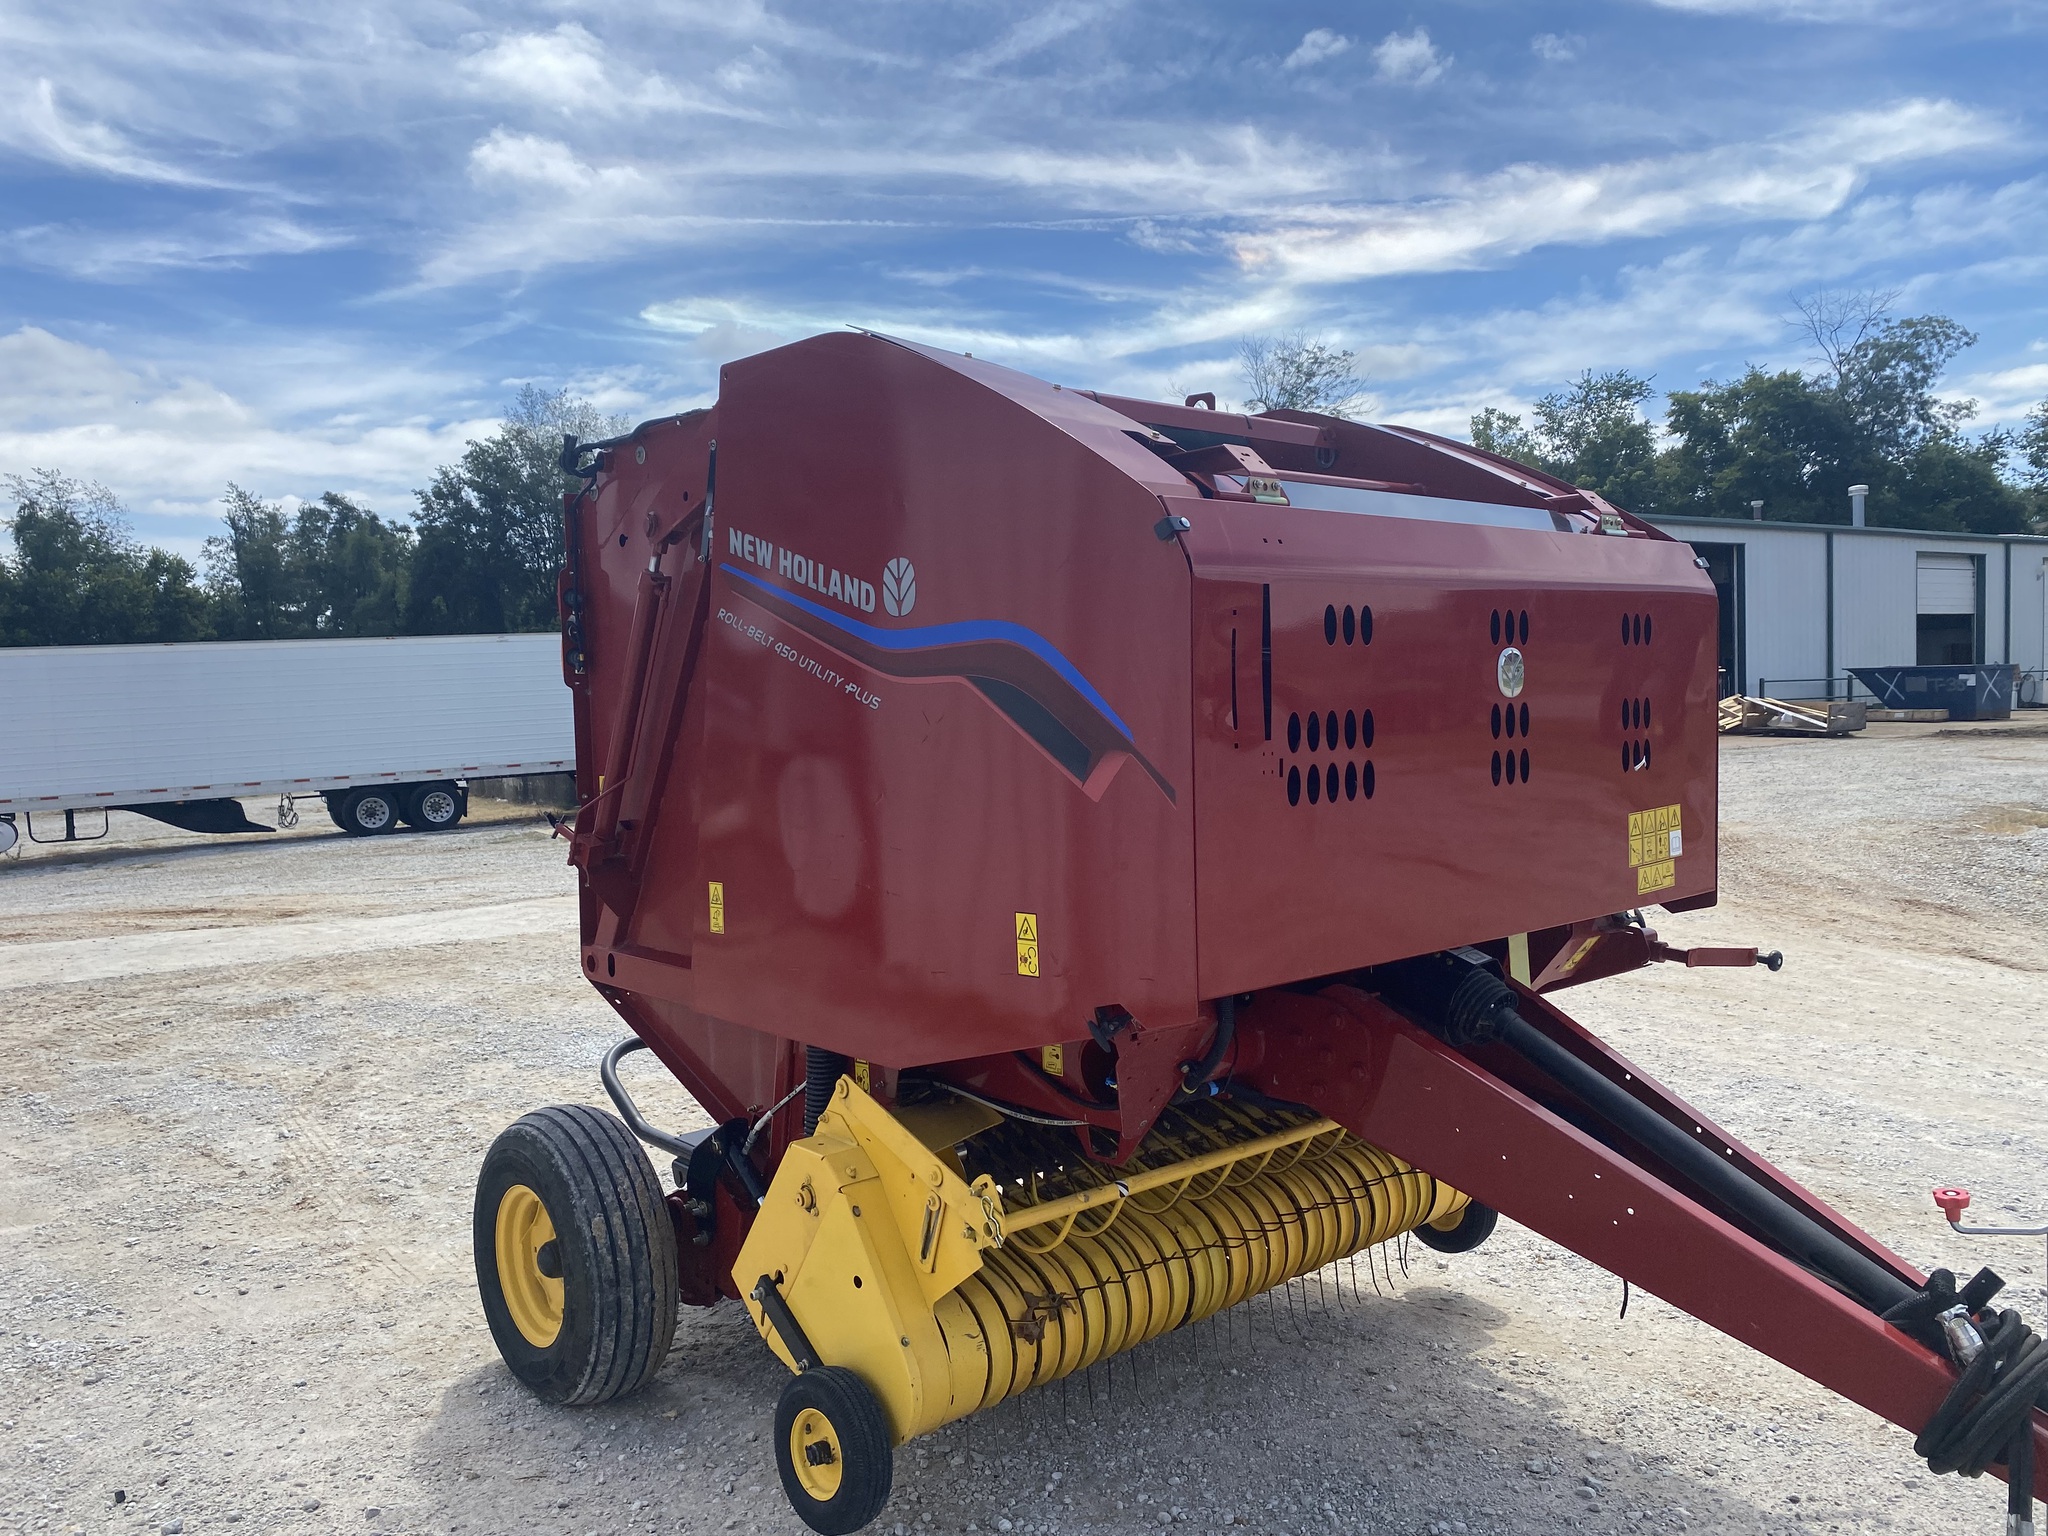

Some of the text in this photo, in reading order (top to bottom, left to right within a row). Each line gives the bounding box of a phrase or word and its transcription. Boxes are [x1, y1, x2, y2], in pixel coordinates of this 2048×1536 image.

[729, 527, 876, 614] NEW HOLLAND
[717, 607, 774, 647] ROLL-BELT
[774, 642, 798, 662] 450
[798, 654, 845, 688] UTILITY
